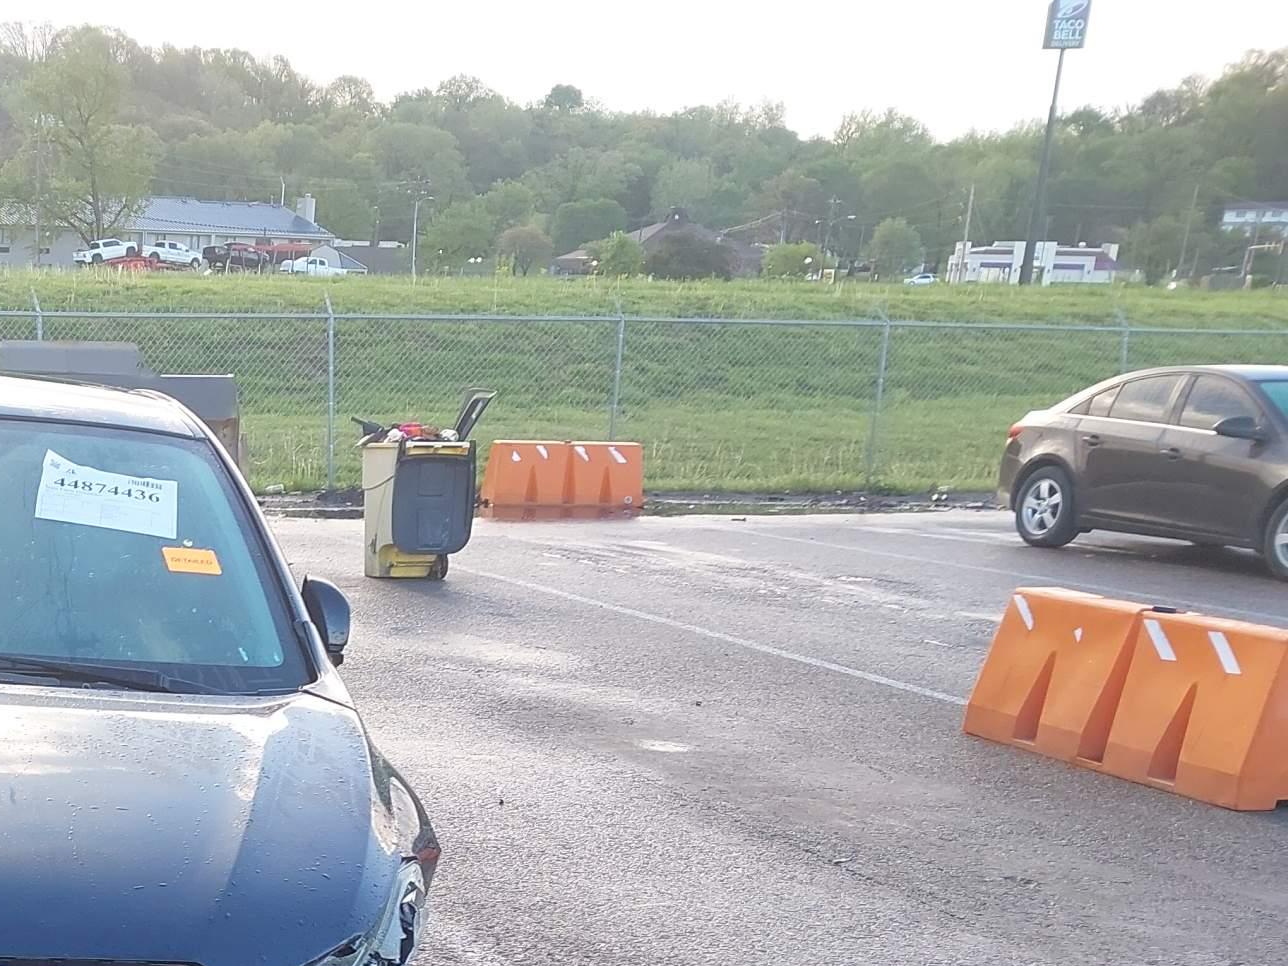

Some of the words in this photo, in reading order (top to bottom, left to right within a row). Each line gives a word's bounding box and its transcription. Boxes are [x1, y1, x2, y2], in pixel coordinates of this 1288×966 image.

[1053, 19, 1085, 30] TACO
[1053, 29, 1082, 40] BELL
[53, 477, 161, 503] 44874436
